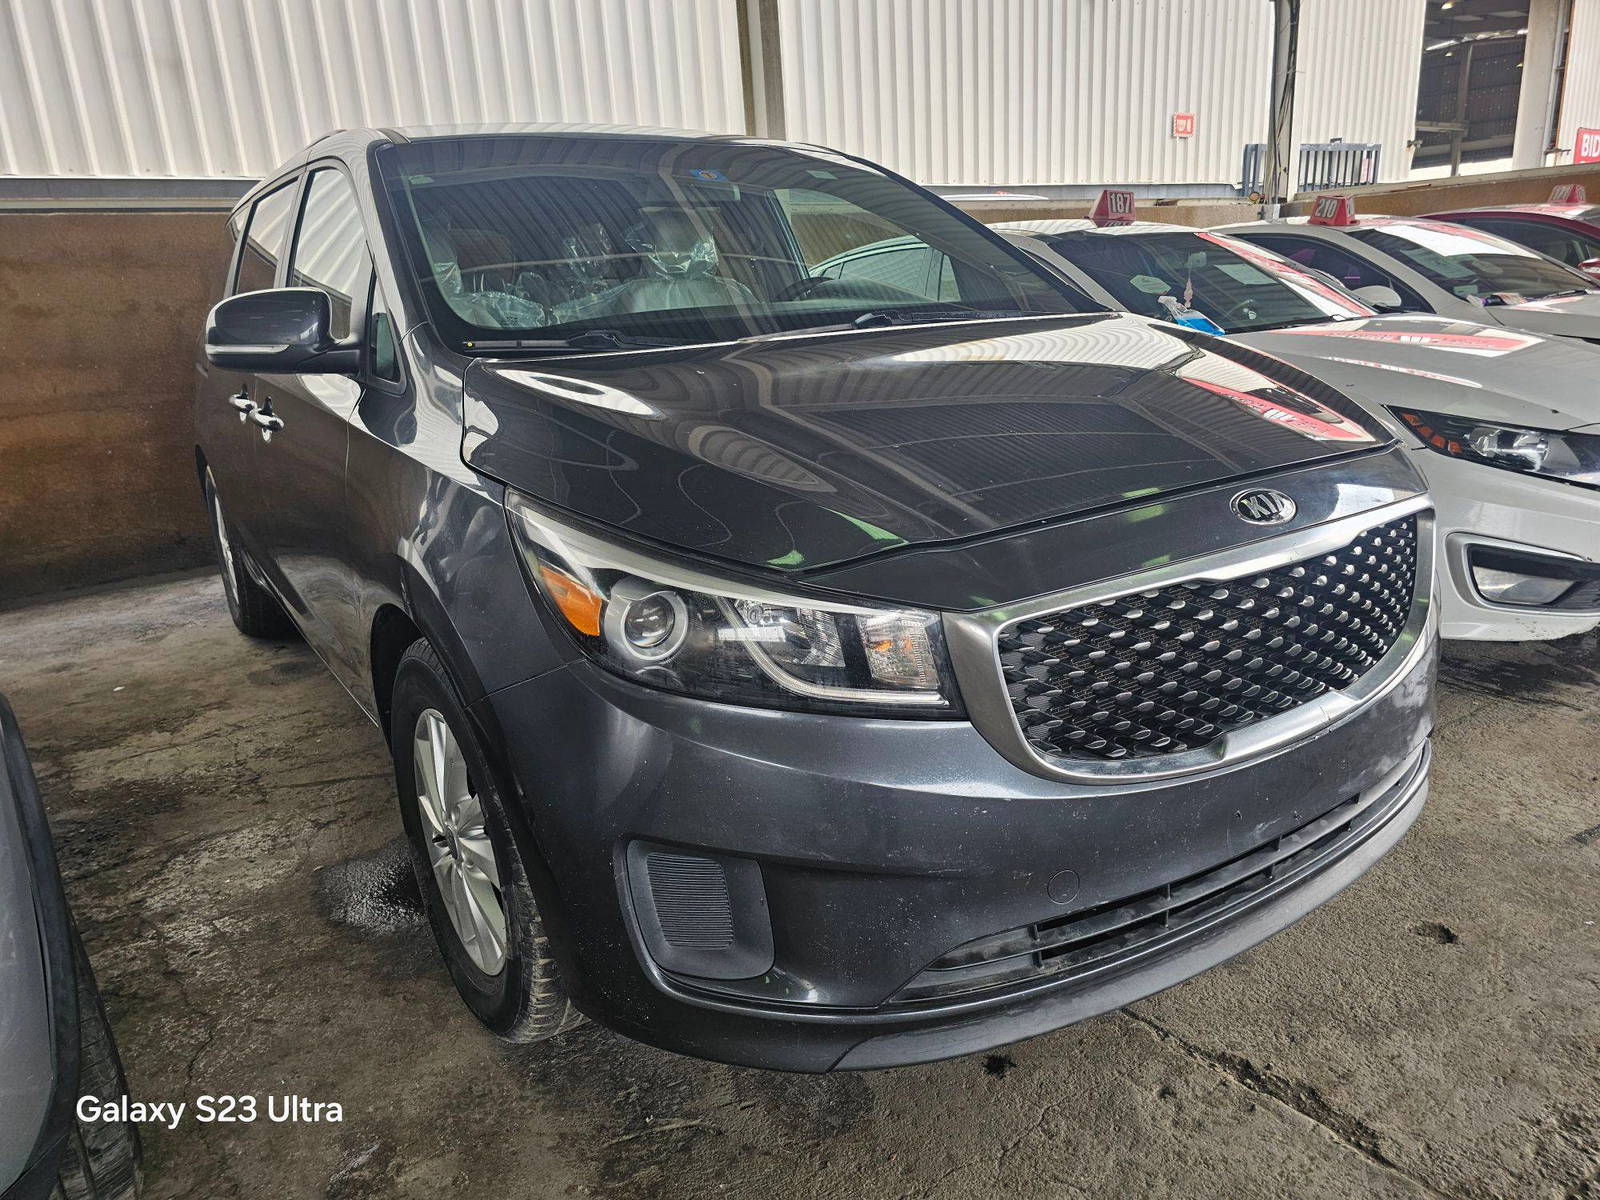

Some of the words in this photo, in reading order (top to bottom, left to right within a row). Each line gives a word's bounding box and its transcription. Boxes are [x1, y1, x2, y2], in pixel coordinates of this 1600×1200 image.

[1110, 192, 1132, 214] 187
[1315, 198, 1338, 218] 210
[1240, 492, 1294, 519] KIA
